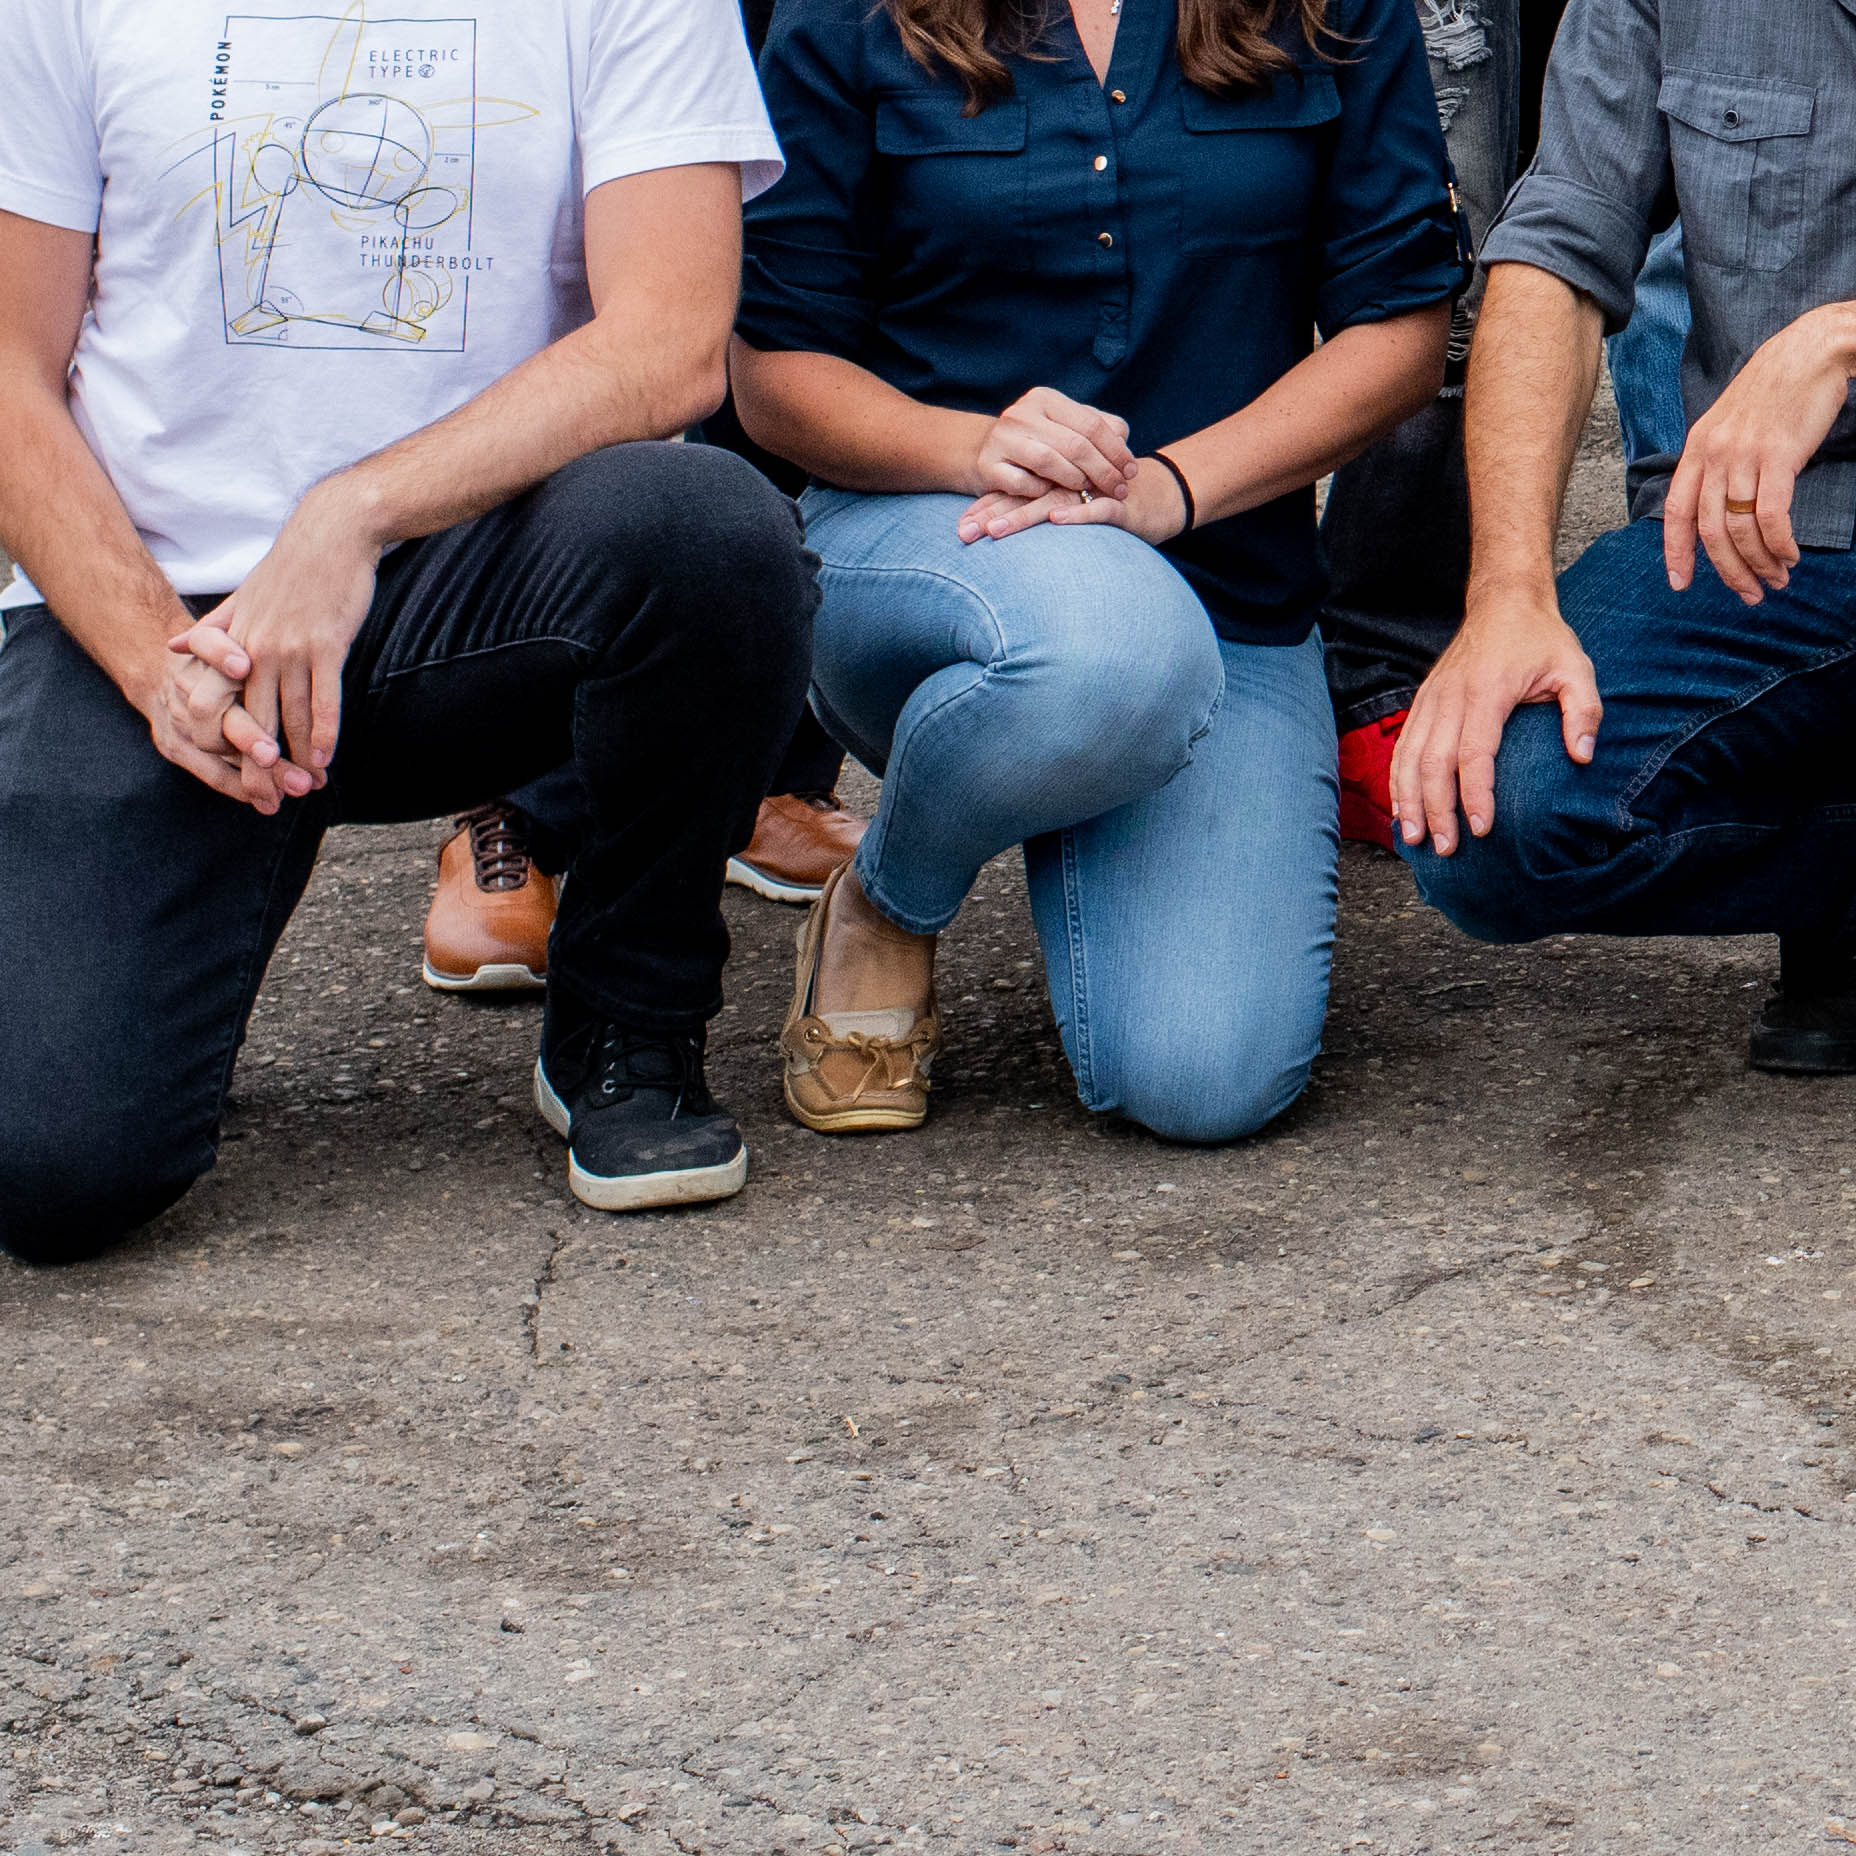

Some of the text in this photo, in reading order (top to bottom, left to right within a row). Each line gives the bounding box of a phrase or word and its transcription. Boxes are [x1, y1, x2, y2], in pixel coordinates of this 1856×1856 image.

[368, 49, 459, 63] ELECTRIC
[368, 66, 414, 79] TYPE
[209, 41, 232, 122] POKÉMON
[360, 235, 435, 251] PIKACHU
[359, 253, 495, 271] THUNDERBOLT
